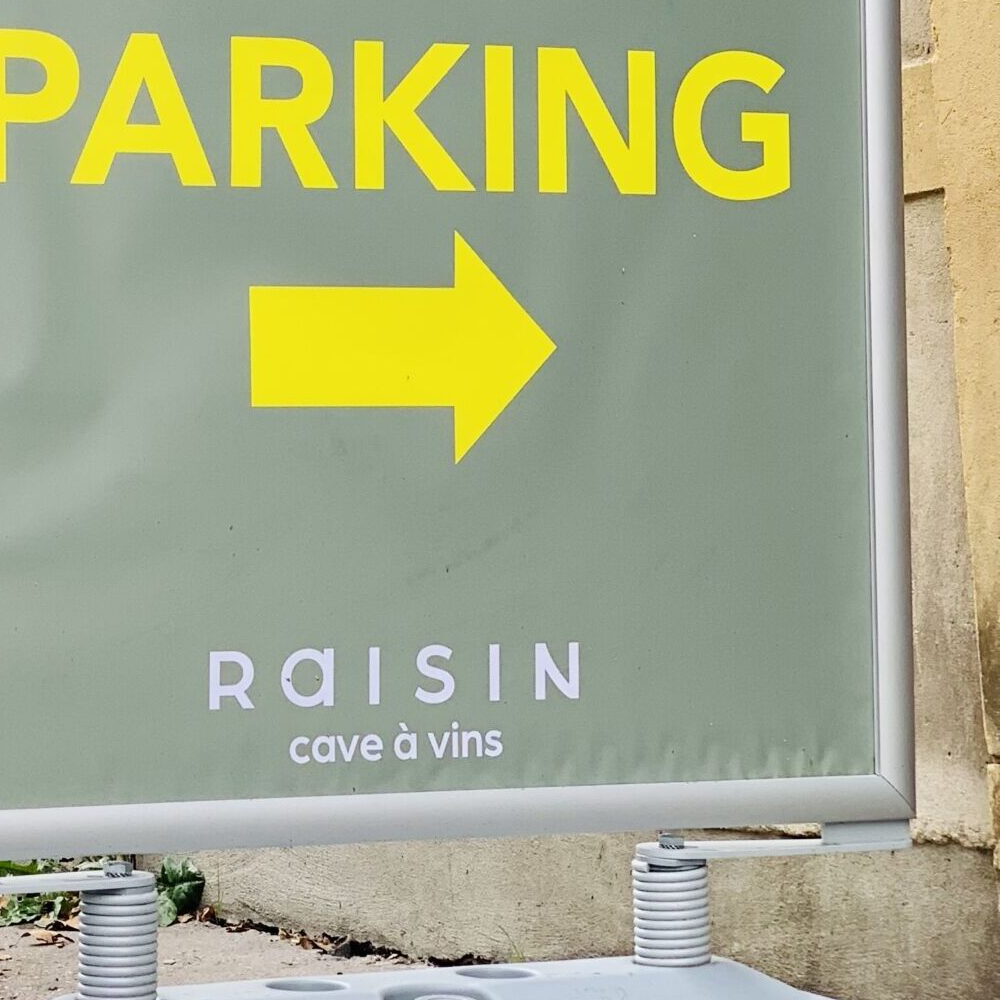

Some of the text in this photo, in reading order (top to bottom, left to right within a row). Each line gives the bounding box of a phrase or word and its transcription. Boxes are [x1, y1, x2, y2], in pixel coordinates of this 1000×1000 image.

[289, 720, 503, 764] cave à vins
